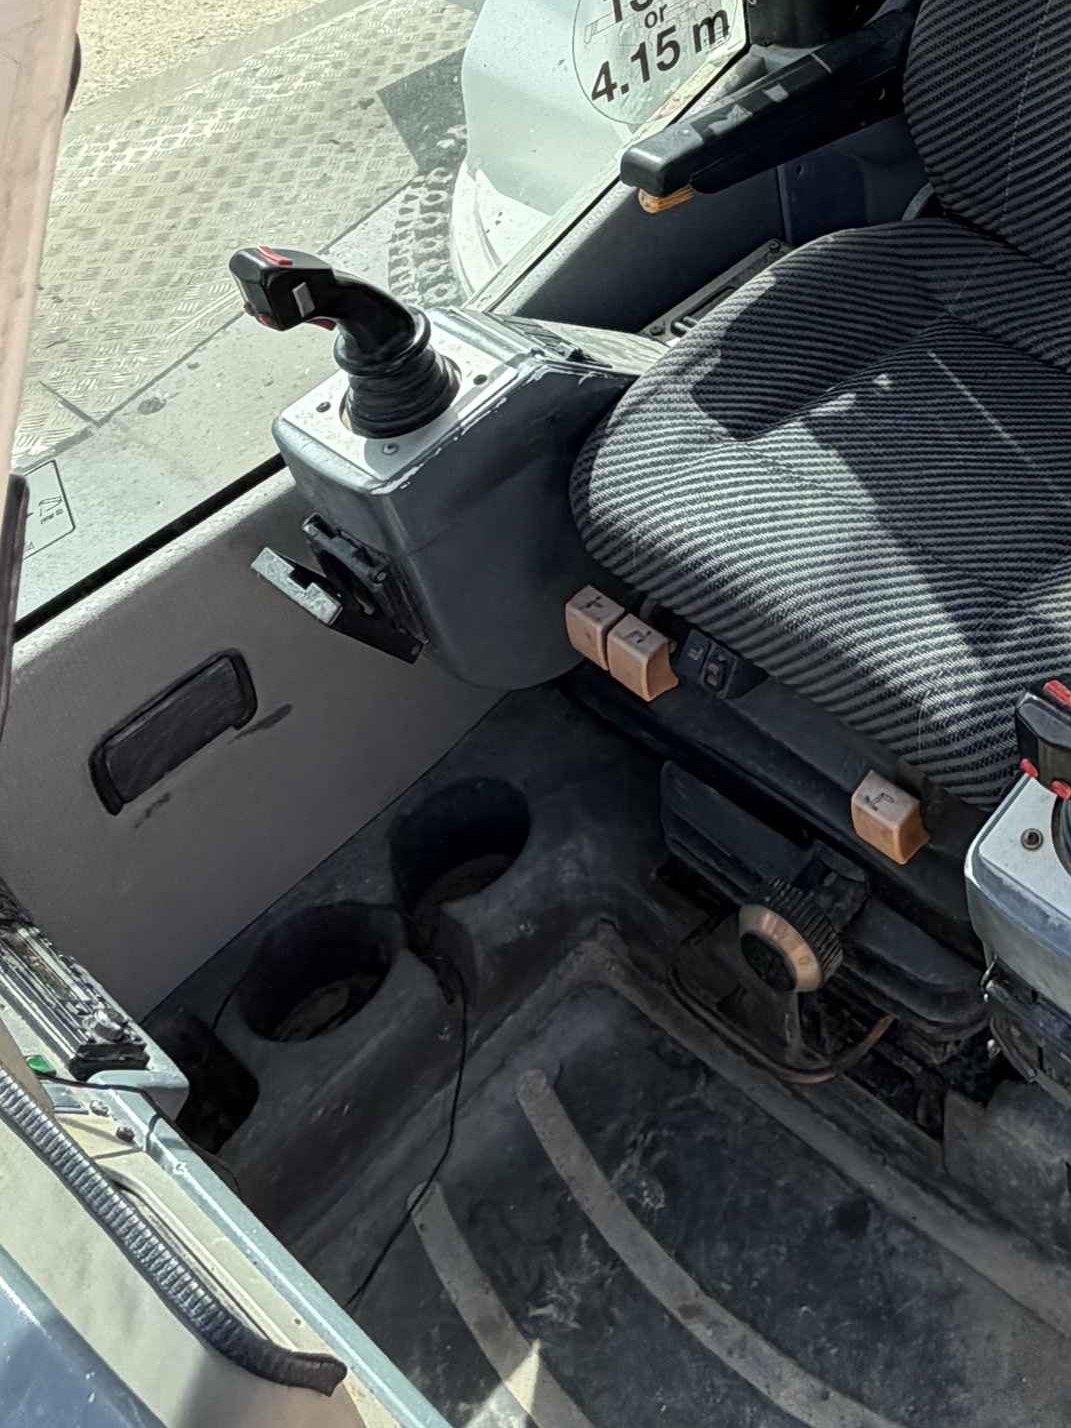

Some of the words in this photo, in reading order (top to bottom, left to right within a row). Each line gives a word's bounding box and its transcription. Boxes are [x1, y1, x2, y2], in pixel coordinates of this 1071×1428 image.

[644, 3, 668, 29] or
[590, 24, 681, 103] 4.15
[692, 8, 730, 55] m
